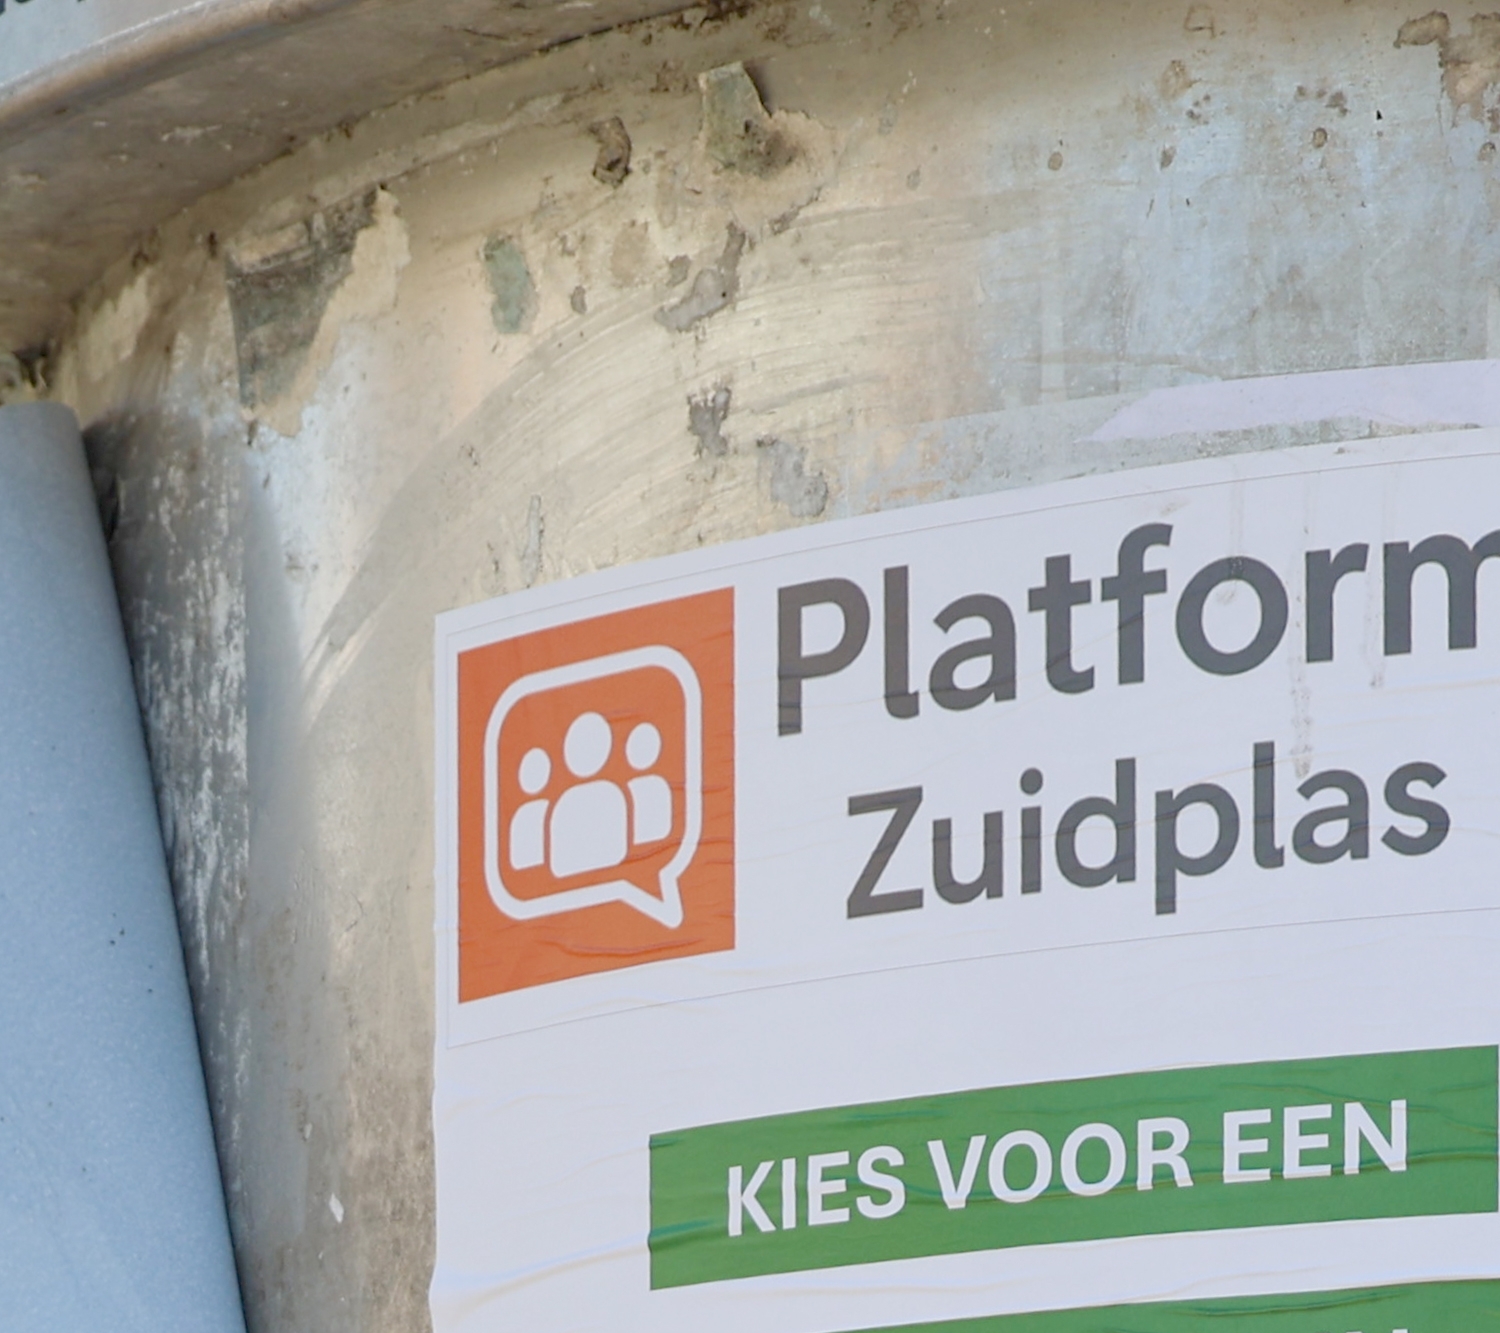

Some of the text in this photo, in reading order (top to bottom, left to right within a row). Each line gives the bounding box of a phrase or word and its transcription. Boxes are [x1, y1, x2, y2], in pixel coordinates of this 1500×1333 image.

[846, 741, 1451, 918] Zuidplas
[726, 1099, 1408, 1237] KIES VOOR EEN
